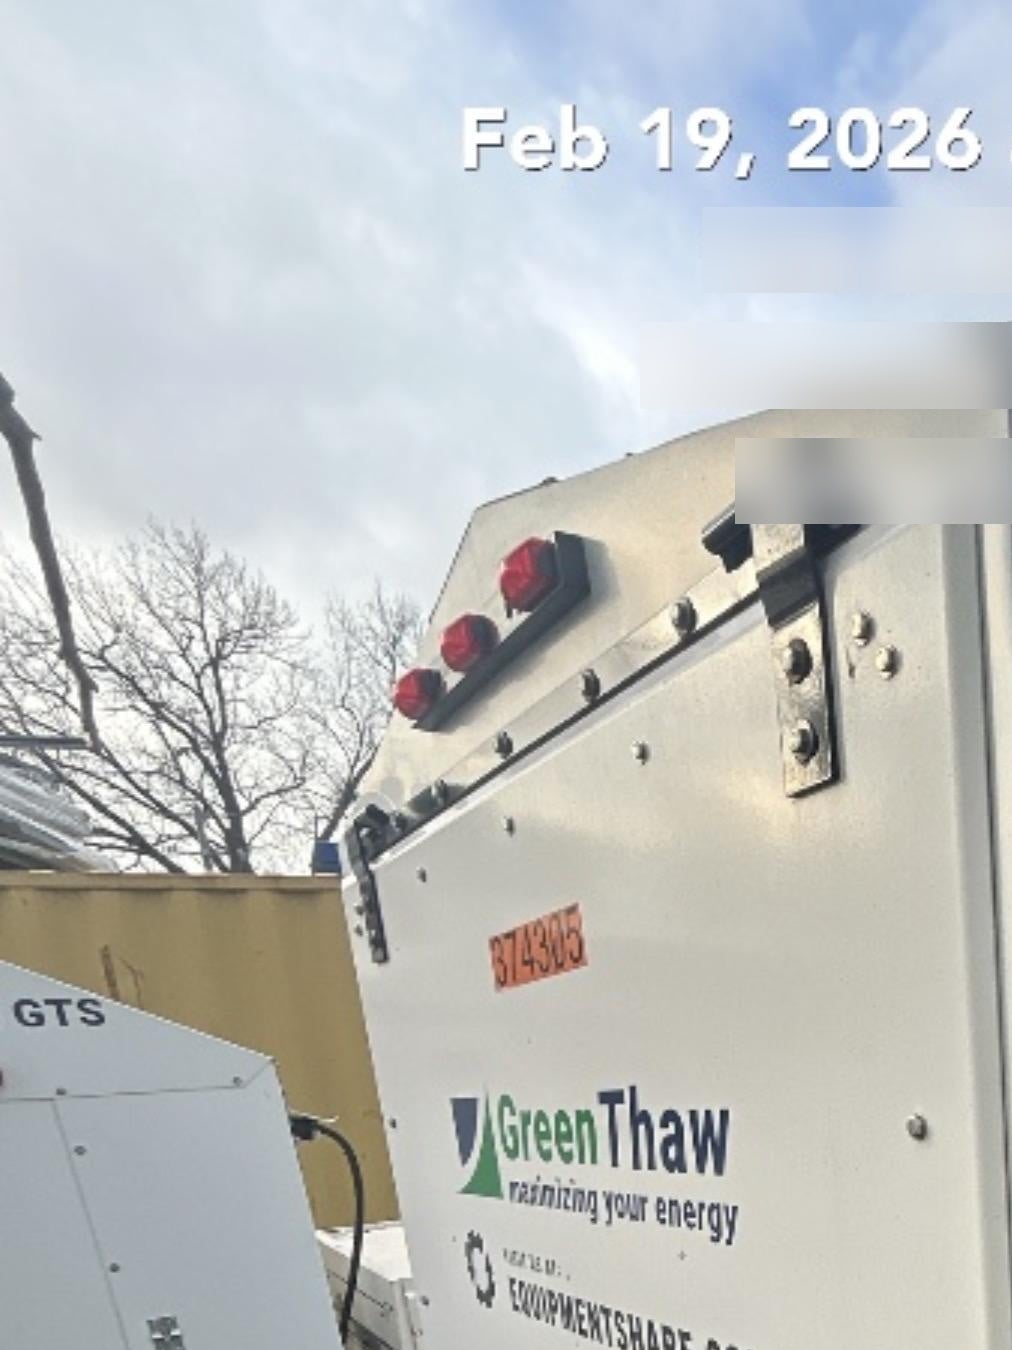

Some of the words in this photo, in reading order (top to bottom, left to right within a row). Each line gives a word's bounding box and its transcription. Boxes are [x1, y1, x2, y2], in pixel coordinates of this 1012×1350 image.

[13, 998, 105, 1027] GTS
[602, 1190, 649, 1226] your
[656, 1197, 739, 1246] energy
